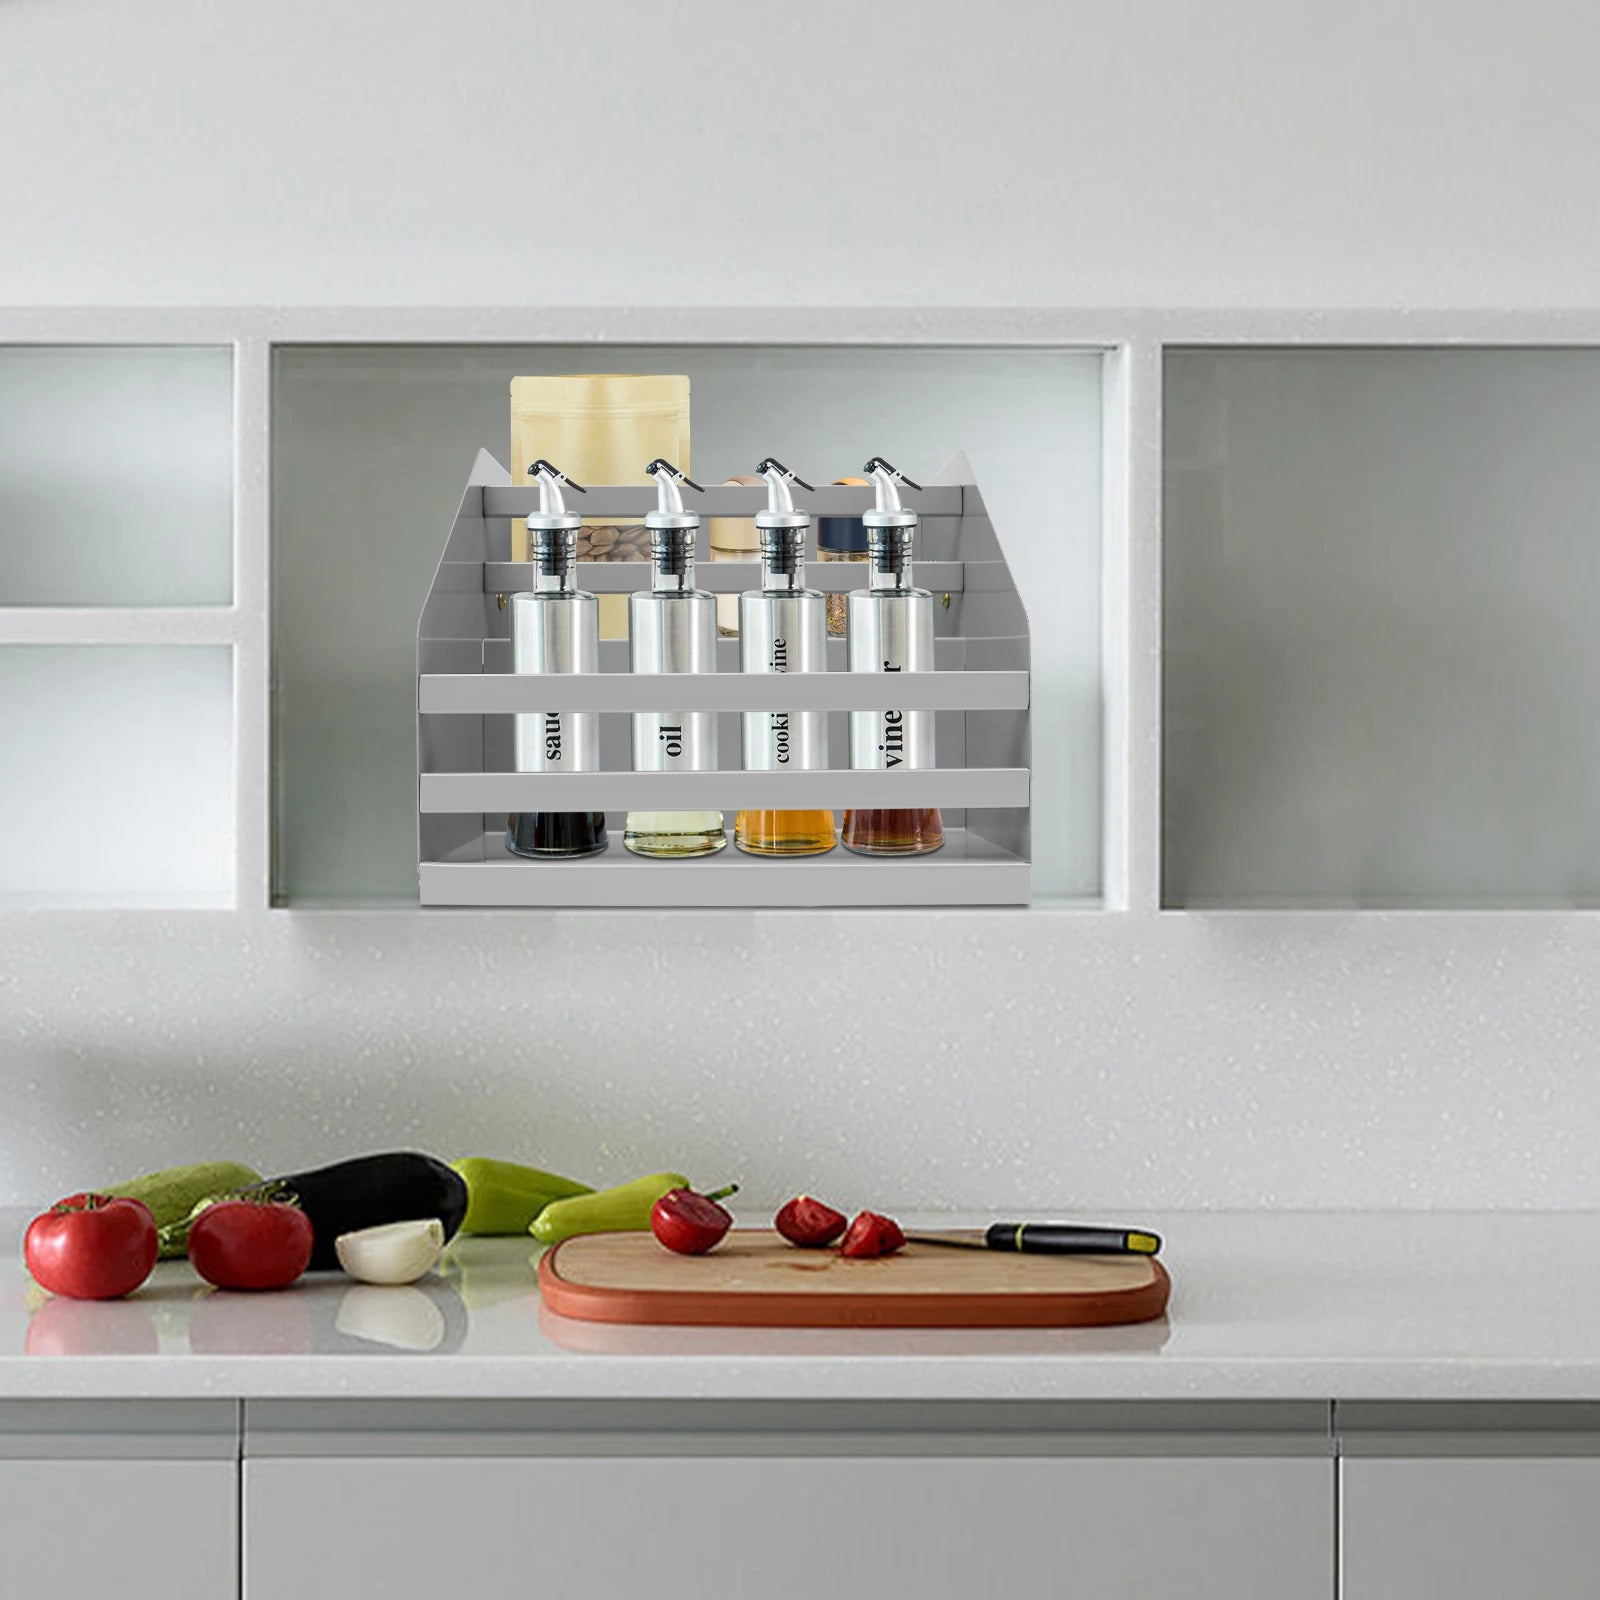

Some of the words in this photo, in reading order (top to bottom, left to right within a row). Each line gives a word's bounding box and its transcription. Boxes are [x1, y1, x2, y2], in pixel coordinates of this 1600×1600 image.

[769, 712, 790, 764] cooki
[878, 660, 903, 769] viner
[659, 725, 682, 757] oil
